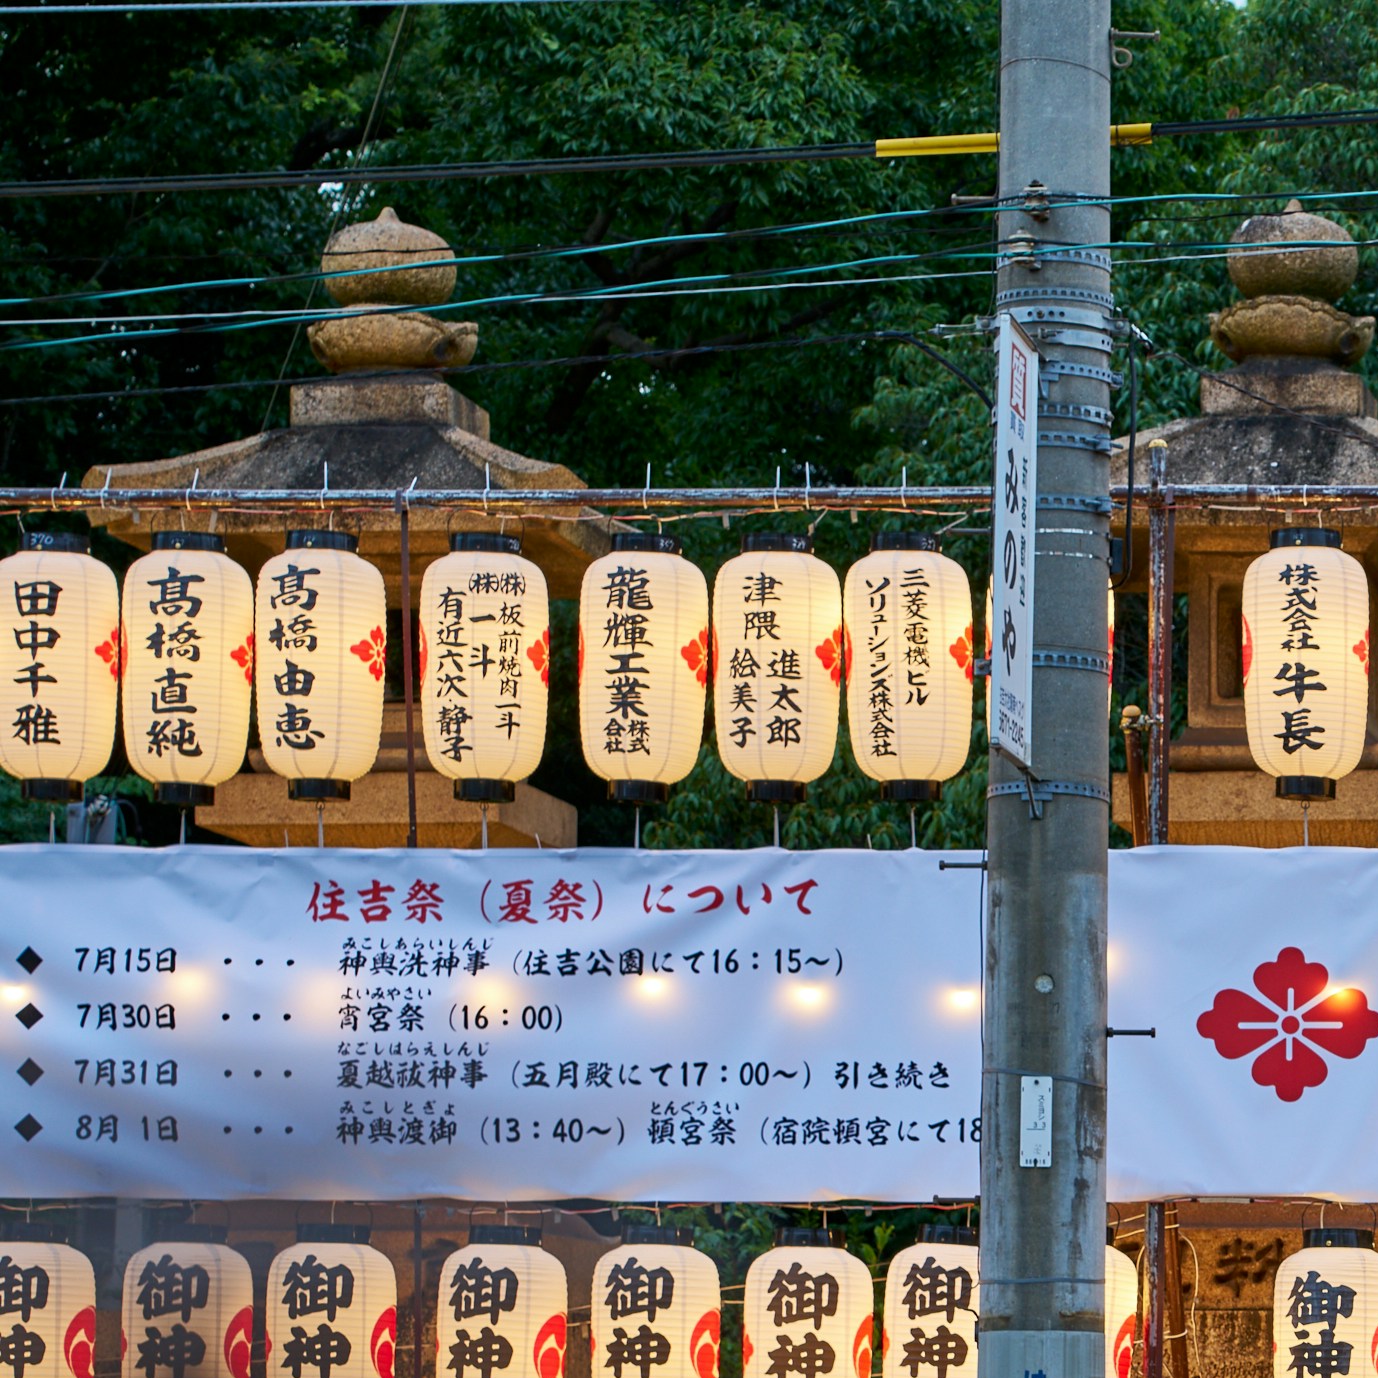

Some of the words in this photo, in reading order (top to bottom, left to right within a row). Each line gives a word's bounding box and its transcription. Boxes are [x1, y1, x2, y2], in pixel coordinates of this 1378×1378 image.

[744, 573, 782, 639] 津隈
[1001, 447, 1019, 677] みのや
[13, 581, 62, 744] 田中千雅
[603, 567, 653, 718] 龍輝工業
[866, 578, 896, 756] ソリューションズ株式会社
[901, 569, 929, 705] 三菱電機ビル
[1273, 564, 1326, 754] 株式会社牛長
[730, 649, 760, 747] 絵美子
[767, 650, 801, 747] 進太郎
[305, 878, 819, 925] 住吉祭（夏祭）について
[74, 946, 178, 975] 7月15日
[340, 986, 433, 1000] よいみやさい
[76, 1003, 177, 1031] 7月30日
[74, 1059, 179, 1088] 7月31日
